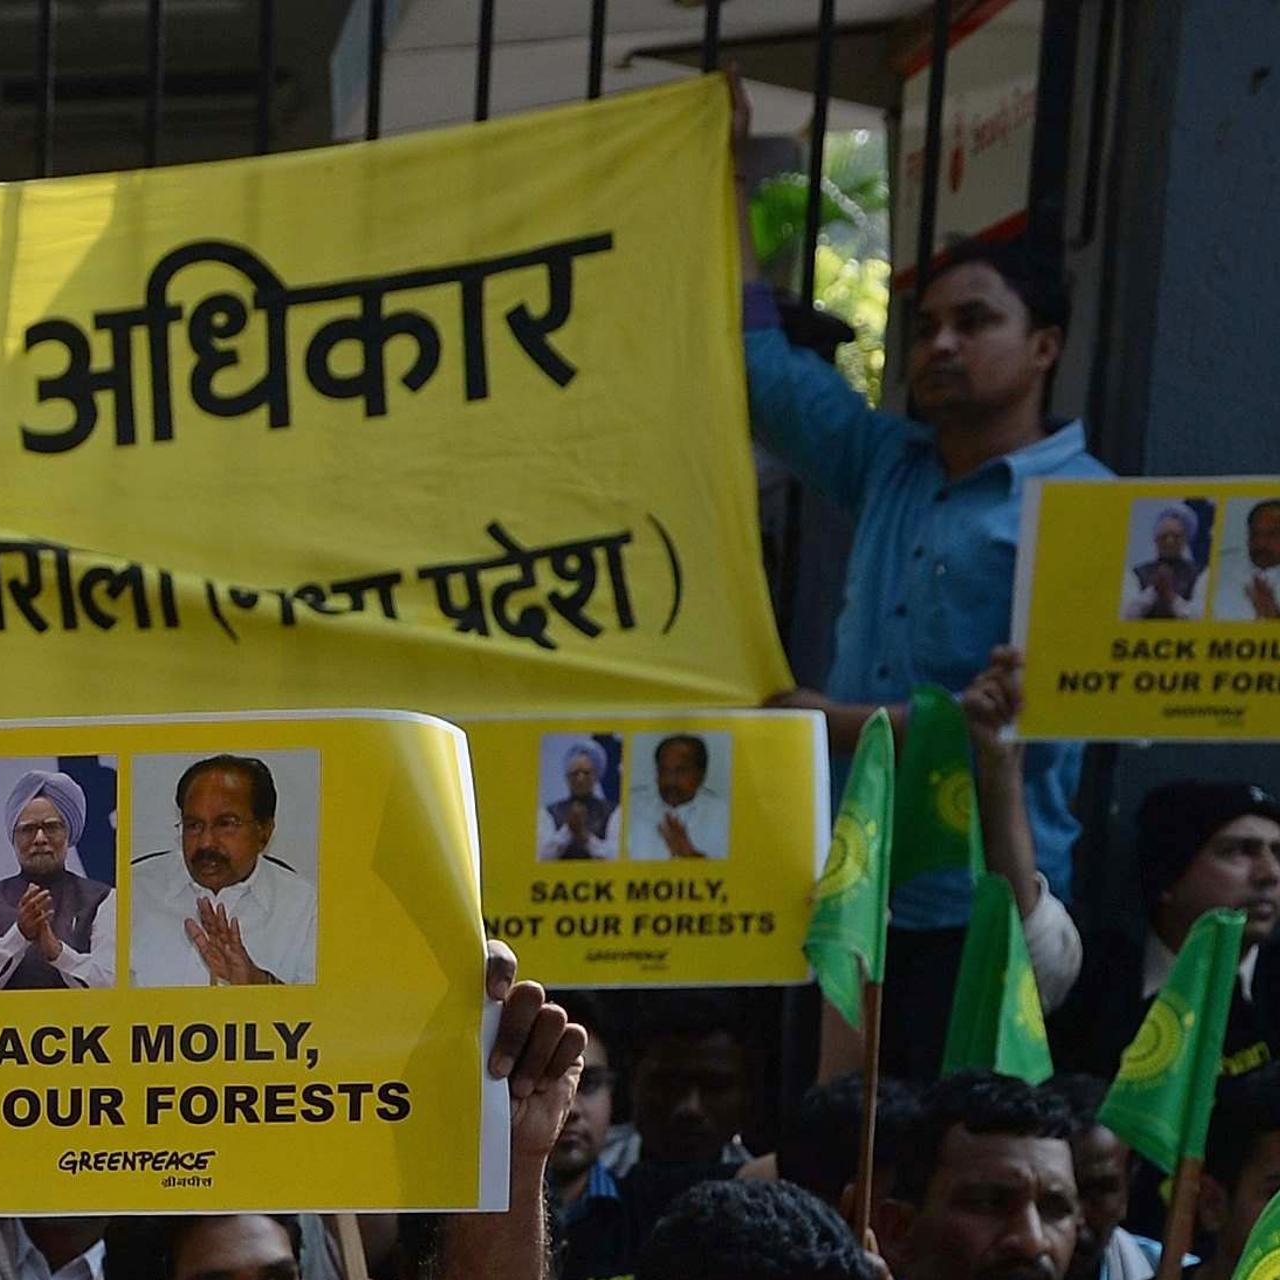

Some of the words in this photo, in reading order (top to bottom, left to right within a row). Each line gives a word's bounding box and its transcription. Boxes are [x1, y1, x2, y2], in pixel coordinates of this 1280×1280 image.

[20, 232, 613, 454] अधिकार
[1111, 638, 1196, 660] SACK
[1208, 637, 1280, 660] MOIL
[1057, 670, 1124, 692] NOT
[1134, 671, 1202, 693] OUR
[1211, 671, 1280, 694] FOR
[530, 880, 613, 903] SACK
[627, 879, 730, 904] MOILY,
[555, 914, 621, 938] OUR
[632, 911, 776, 937] FORESTS
[130, 1021, 320, 1071] MOILY,
[1, 1087, 127, 1128] OUR
[145, 1081, 411, 1125] FORESTS
[57, 1149, 217, 1174] GREENPEACE
